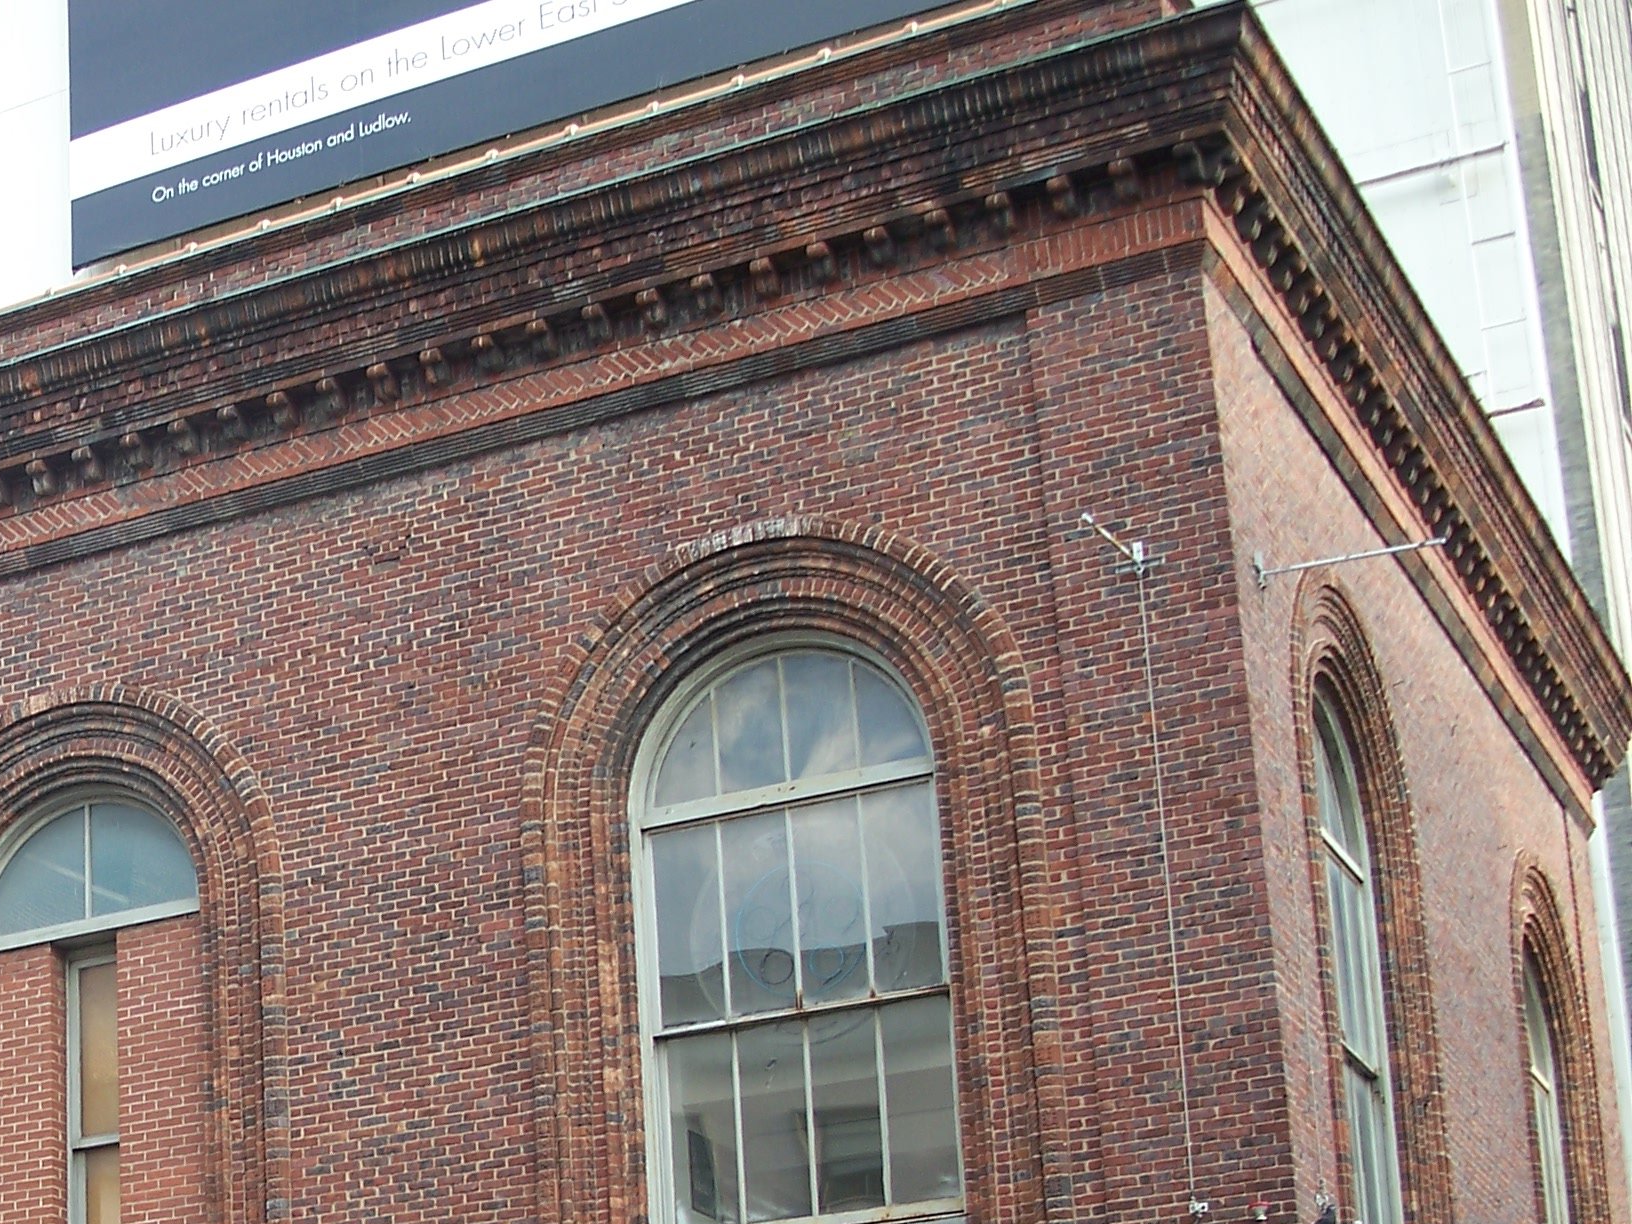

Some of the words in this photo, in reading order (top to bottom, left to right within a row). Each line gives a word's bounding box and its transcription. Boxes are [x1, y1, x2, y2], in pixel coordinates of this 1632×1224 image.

[150, 115, 231, 156] Luxury
[241, 76, 329, 126] rentals
[340, 68, 374, 92] on
[387, 48, 428, 78] the
[441, 18, 525, 61] Lower
[151, 186, 175, 203] On
[178, 177, 199, 195] the
[202, 164, 245, 187] corner
[248, 152, 265, 172] of
[266, 138, 323, 167] Houston
[326, 123, 355, 148] and
[359, 110, 412, 138] Ludlow.
